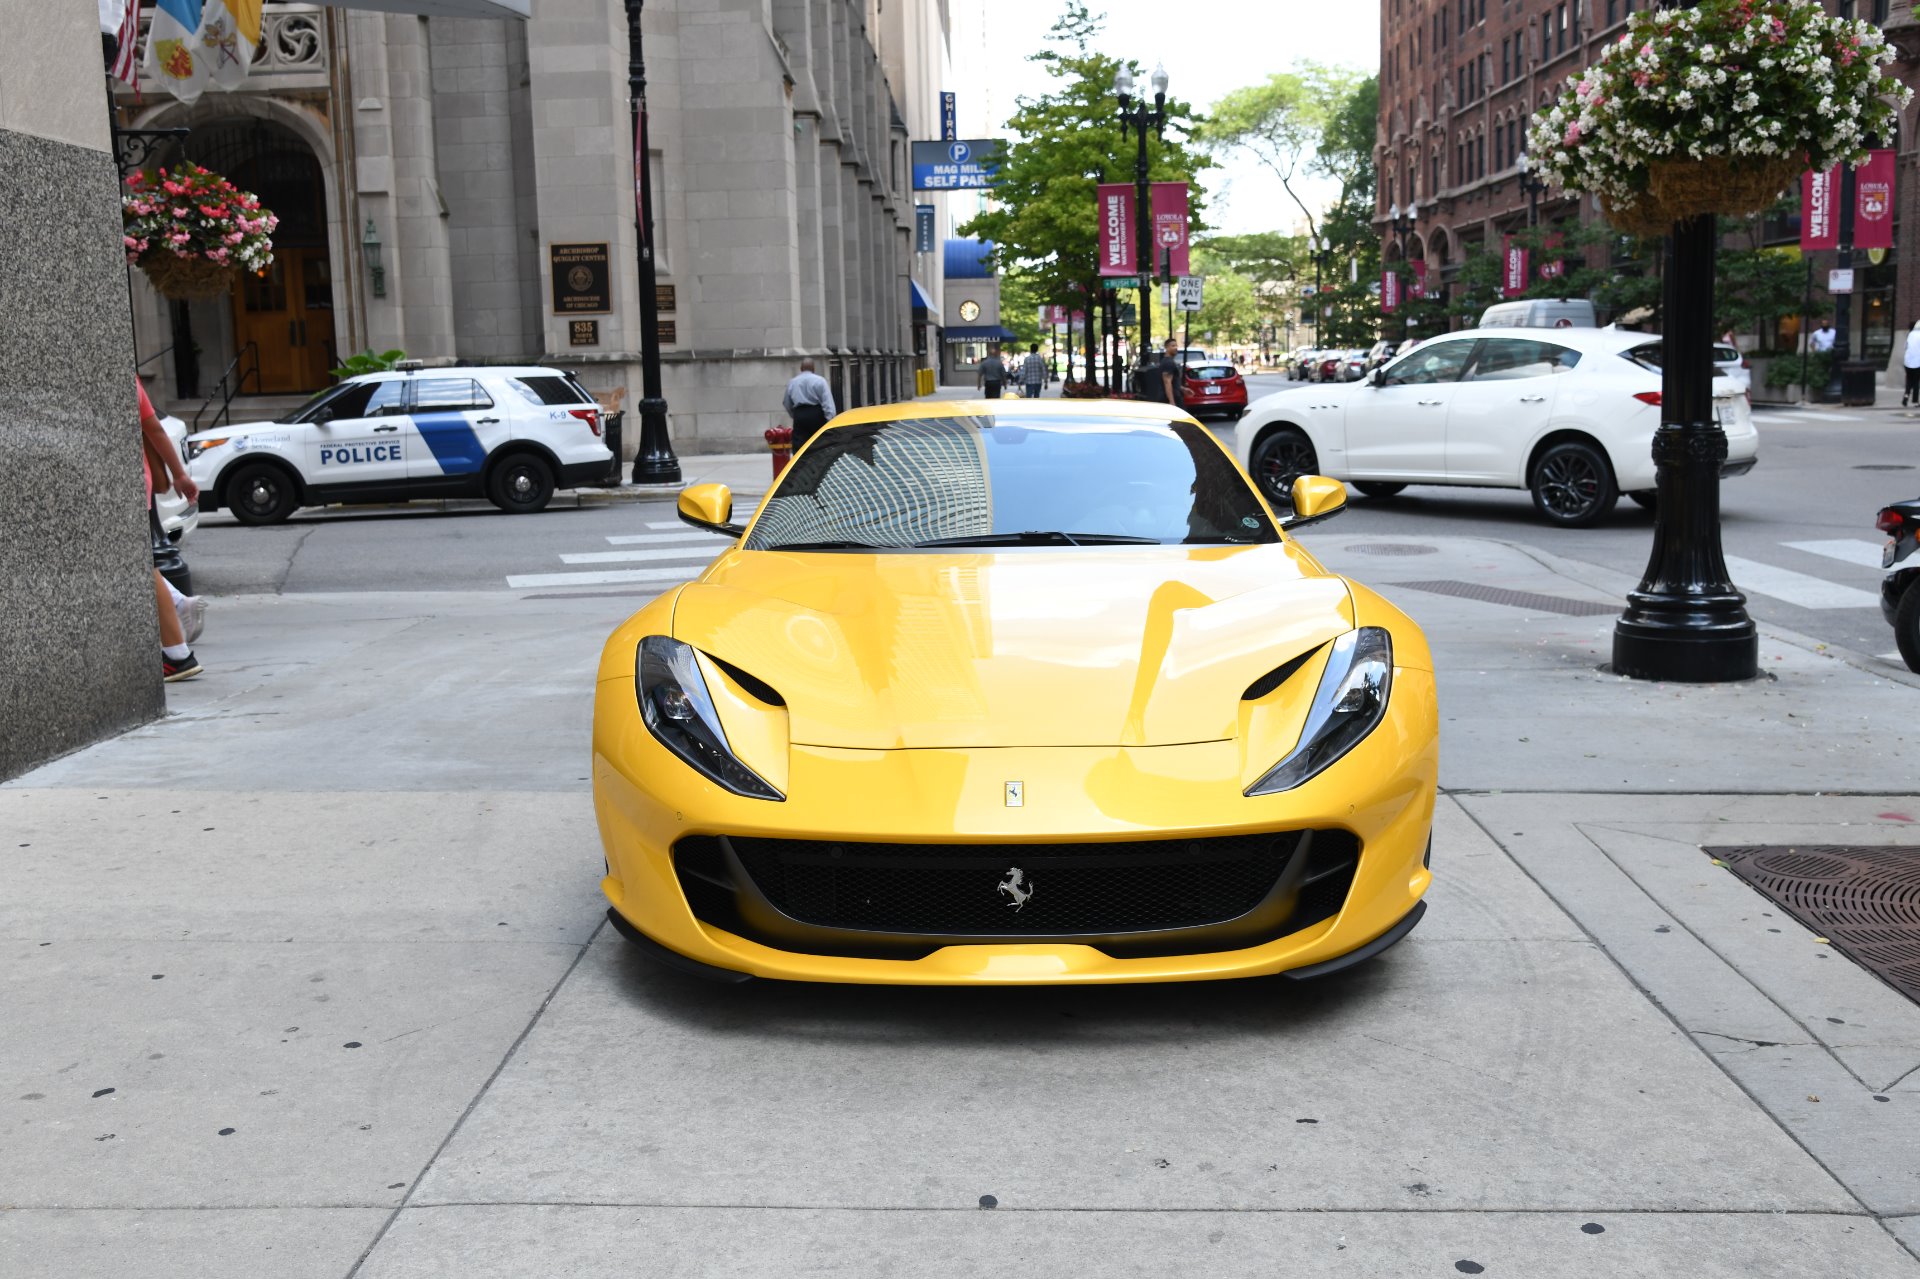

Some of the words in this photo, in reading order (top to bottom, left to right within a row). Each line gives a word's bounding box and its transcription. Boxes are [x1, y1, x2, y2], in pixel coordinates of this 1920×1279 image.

[954, 145, 966, 160] P
[934, 165, 958, 174] MAG
[961, 164, 986, 174] MIL
[924, 175, 957, 187] SELF
[1810, 172, 1824, 238] WELCOM
[1108, 195, 1121, 266] WELCOME
[1508, 248, 1517, 289] WELCOM
[1181, 279, 1200, 288] ONE
[1180, 289, 1200, 298] WAY
[575, 322, 593, 333] 835
[550, 410, 567, 420] K-9
[321, 445, 402, 465] POLICE
